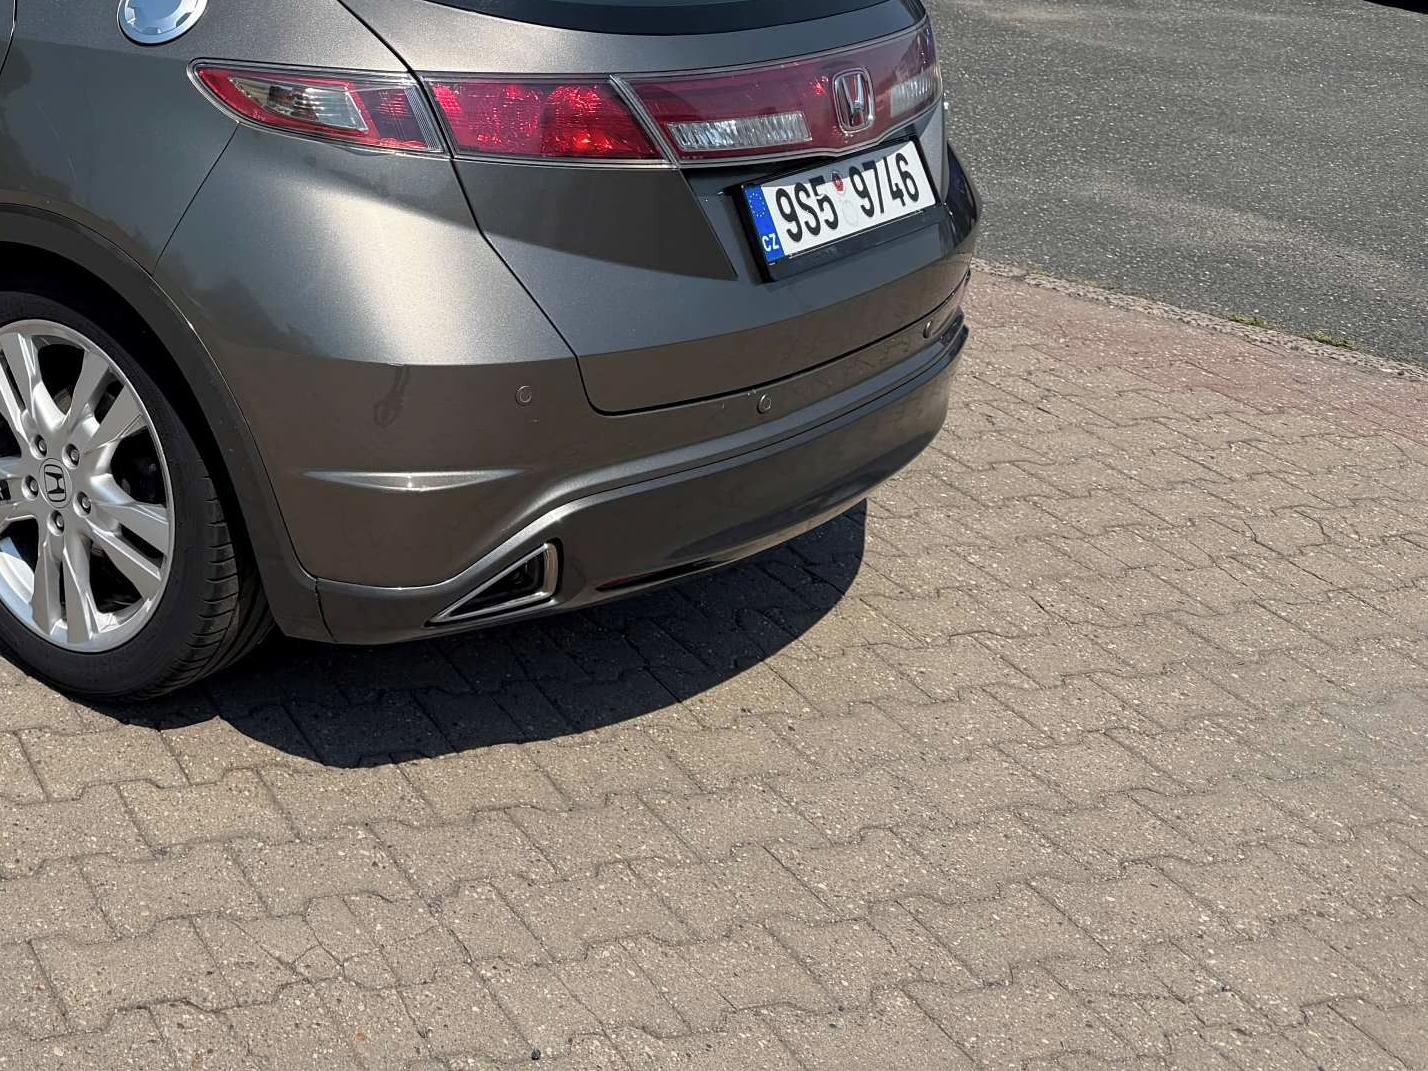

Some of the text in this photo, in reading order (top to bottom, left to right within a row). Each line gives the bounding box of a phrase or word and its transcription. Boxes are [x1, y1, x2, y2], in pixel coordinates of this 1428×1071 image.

[775, 152, 920, 243] 9S5 9746
[761, 233, 780, 252] CZ
